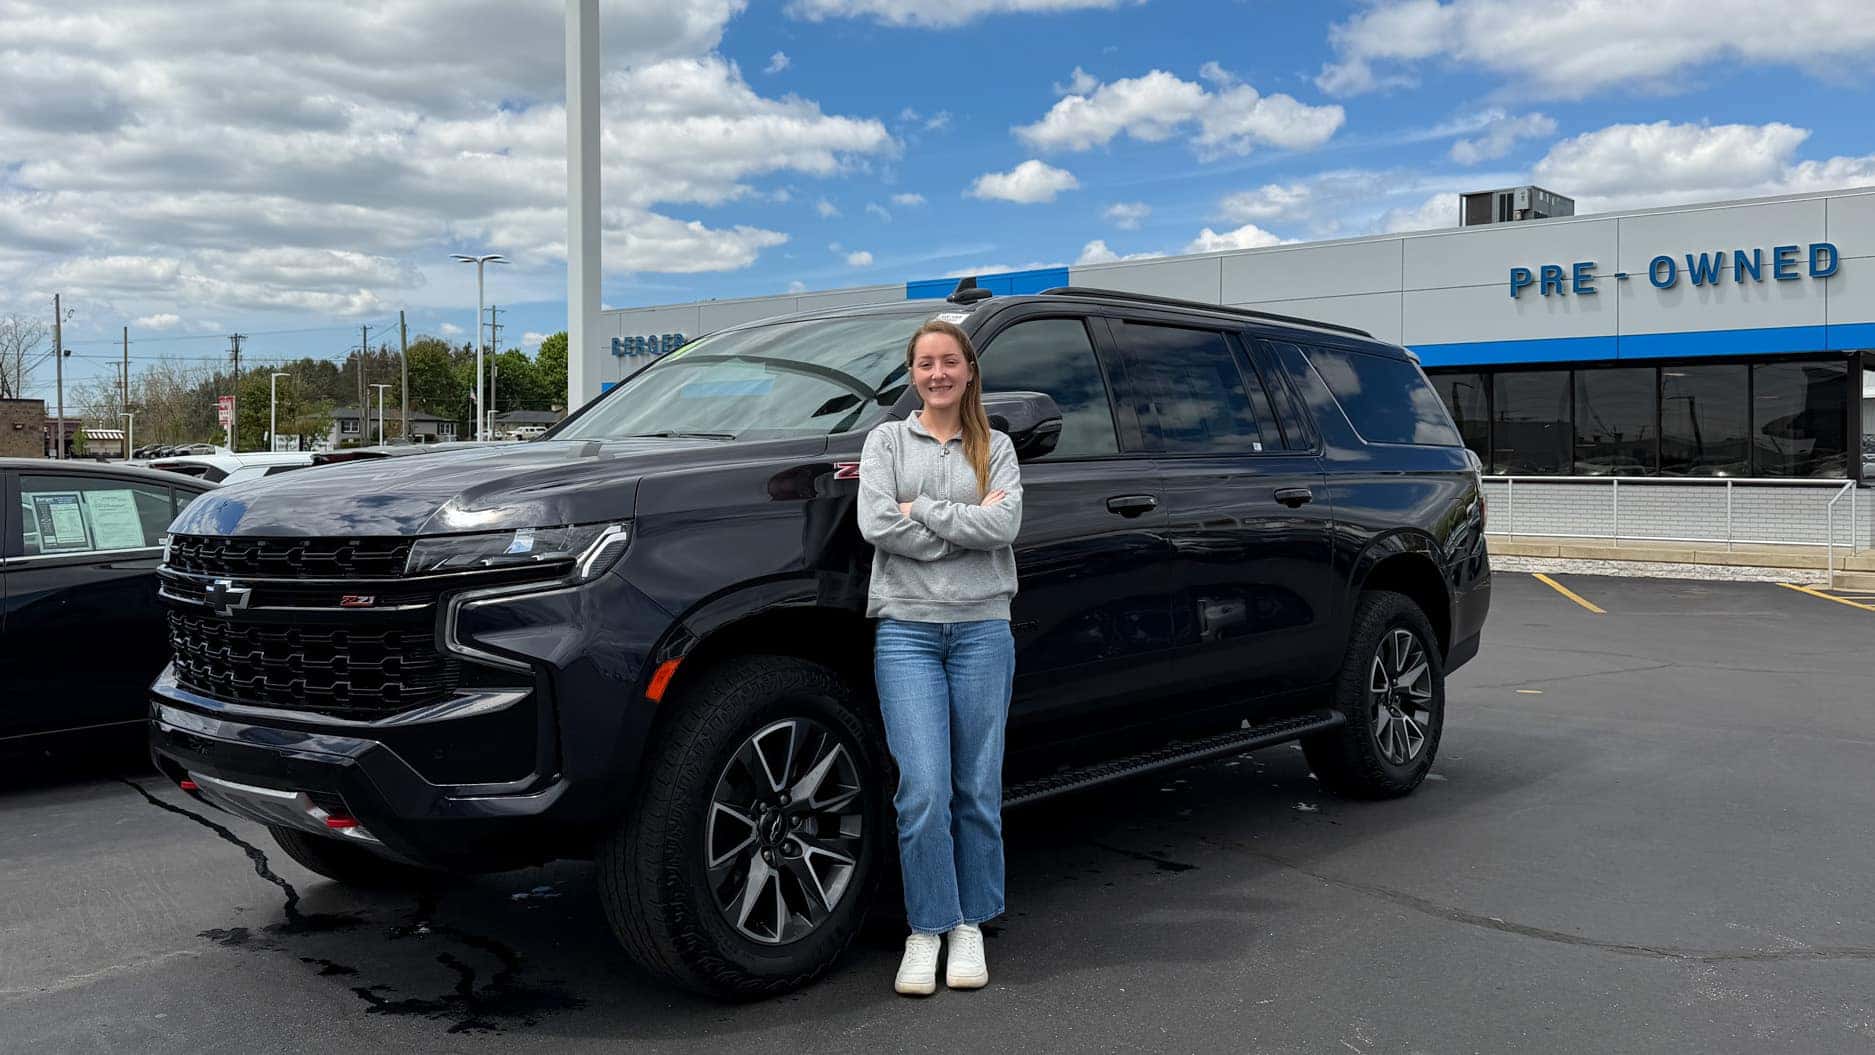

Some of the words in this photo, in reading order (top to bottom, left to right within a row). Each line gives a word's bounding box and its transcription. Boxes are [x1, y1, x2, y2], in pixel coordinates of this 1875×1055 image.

[1510, 261, 1598, 298] PRE
[1649, 242, 1840, 289] OWNED
[611, 333, 685, 356] BERGER
